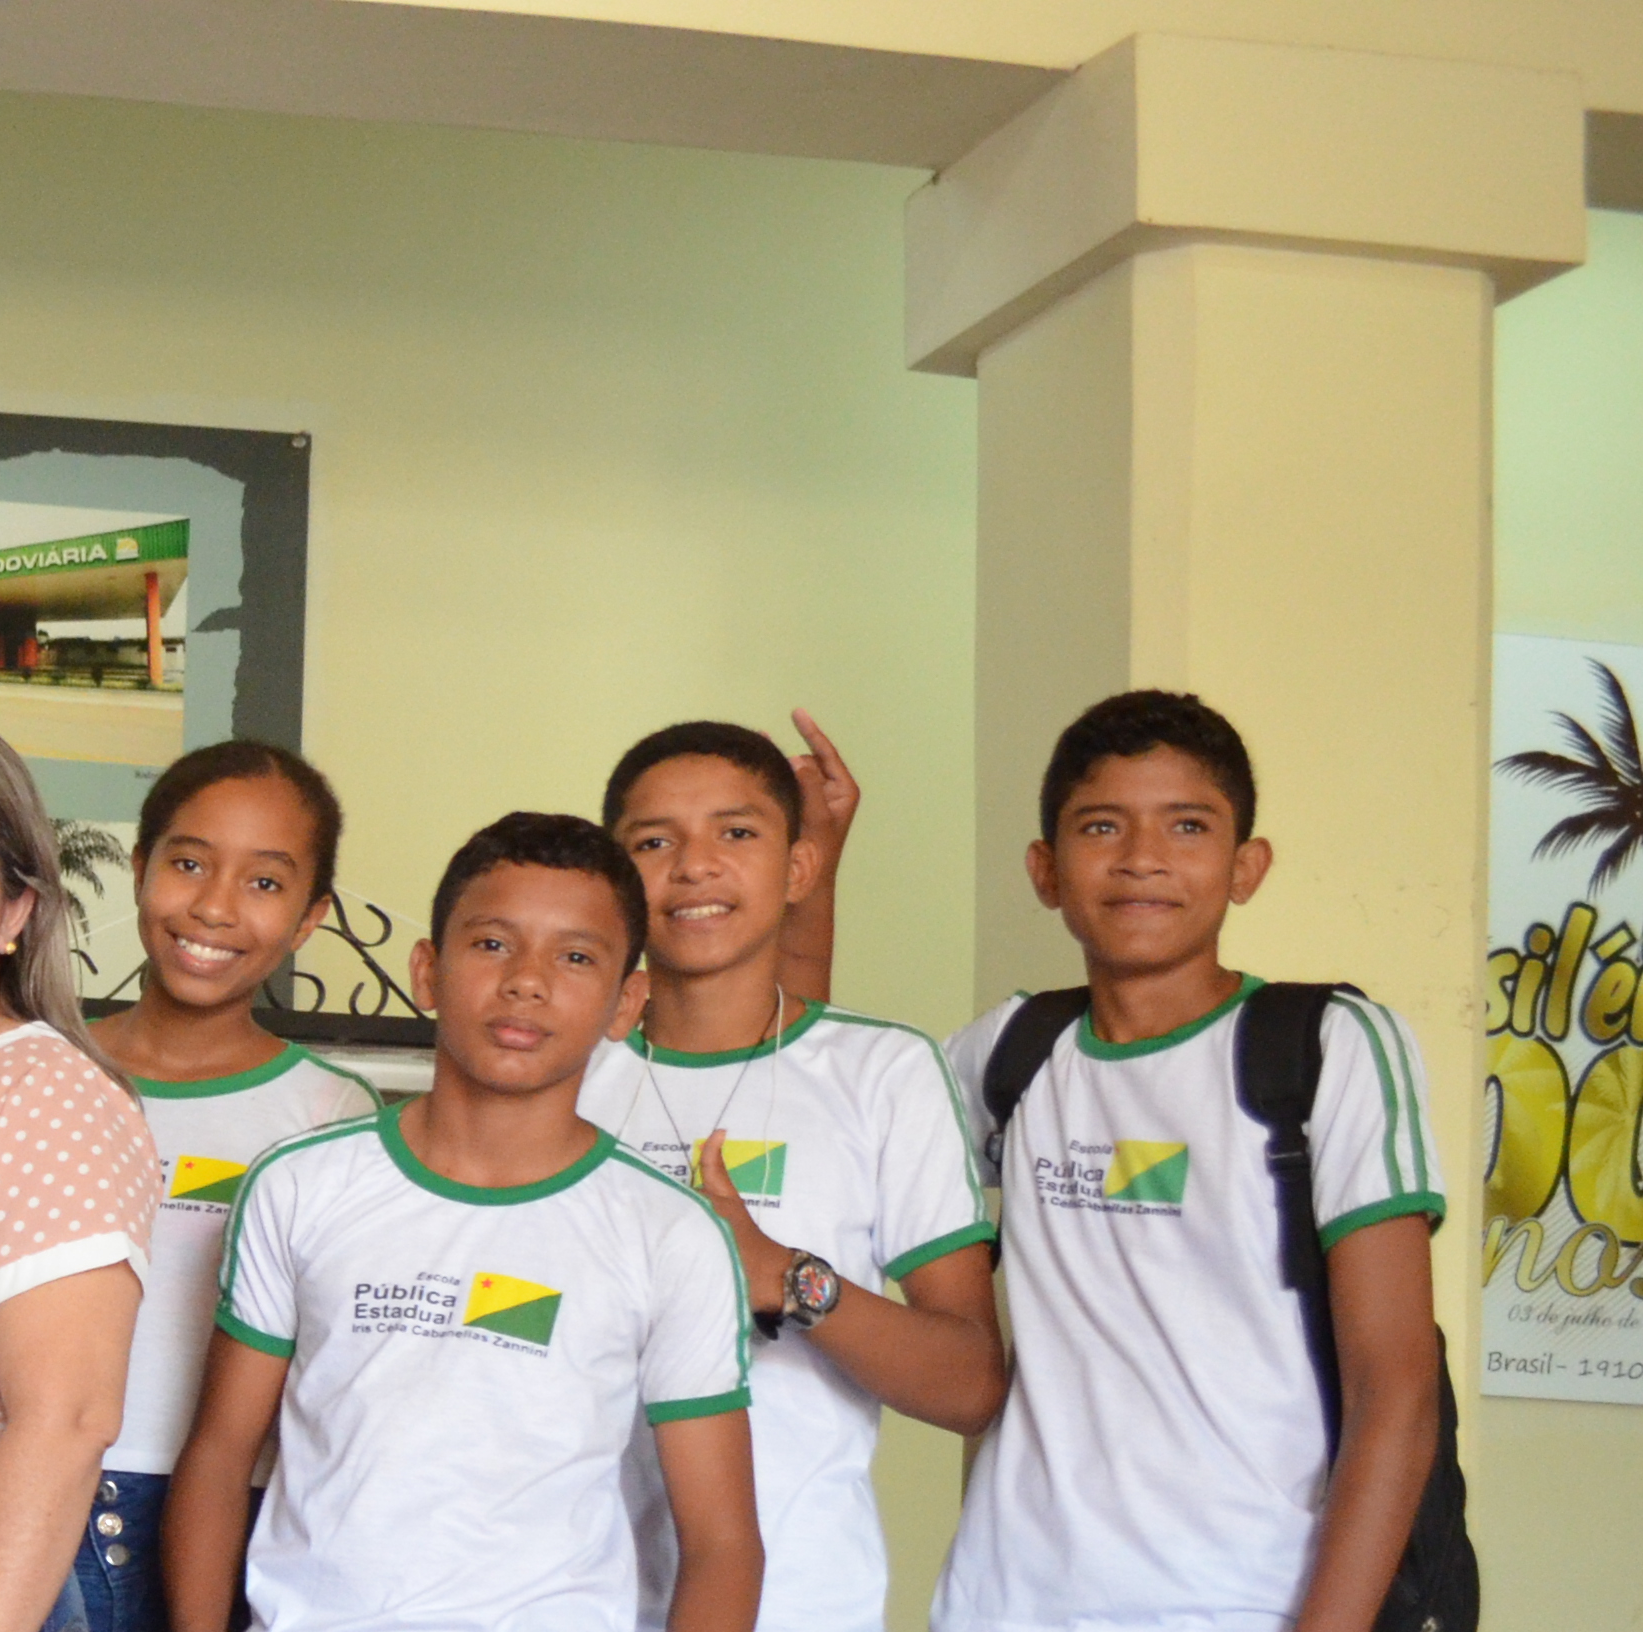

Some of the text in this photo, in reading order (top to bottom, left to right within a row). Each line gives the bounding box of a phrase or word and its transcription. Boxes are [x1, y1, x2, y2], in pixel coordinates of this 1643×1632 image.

[1069, 1140, 1113, 1155] Escola
[416, 1271, 461, 1287] Escola
[354, 1283, 457, 1308] Pública
[354, 1303, 453, 1325] Estadual
[1507, 1302, 1640, 1336] 03 de julho de
[412, 1326, 488, 1343] Cabanellas
[492, 1336, 549, 1359] Zannini
[1578, 1358, 1643, 1380] 1910
